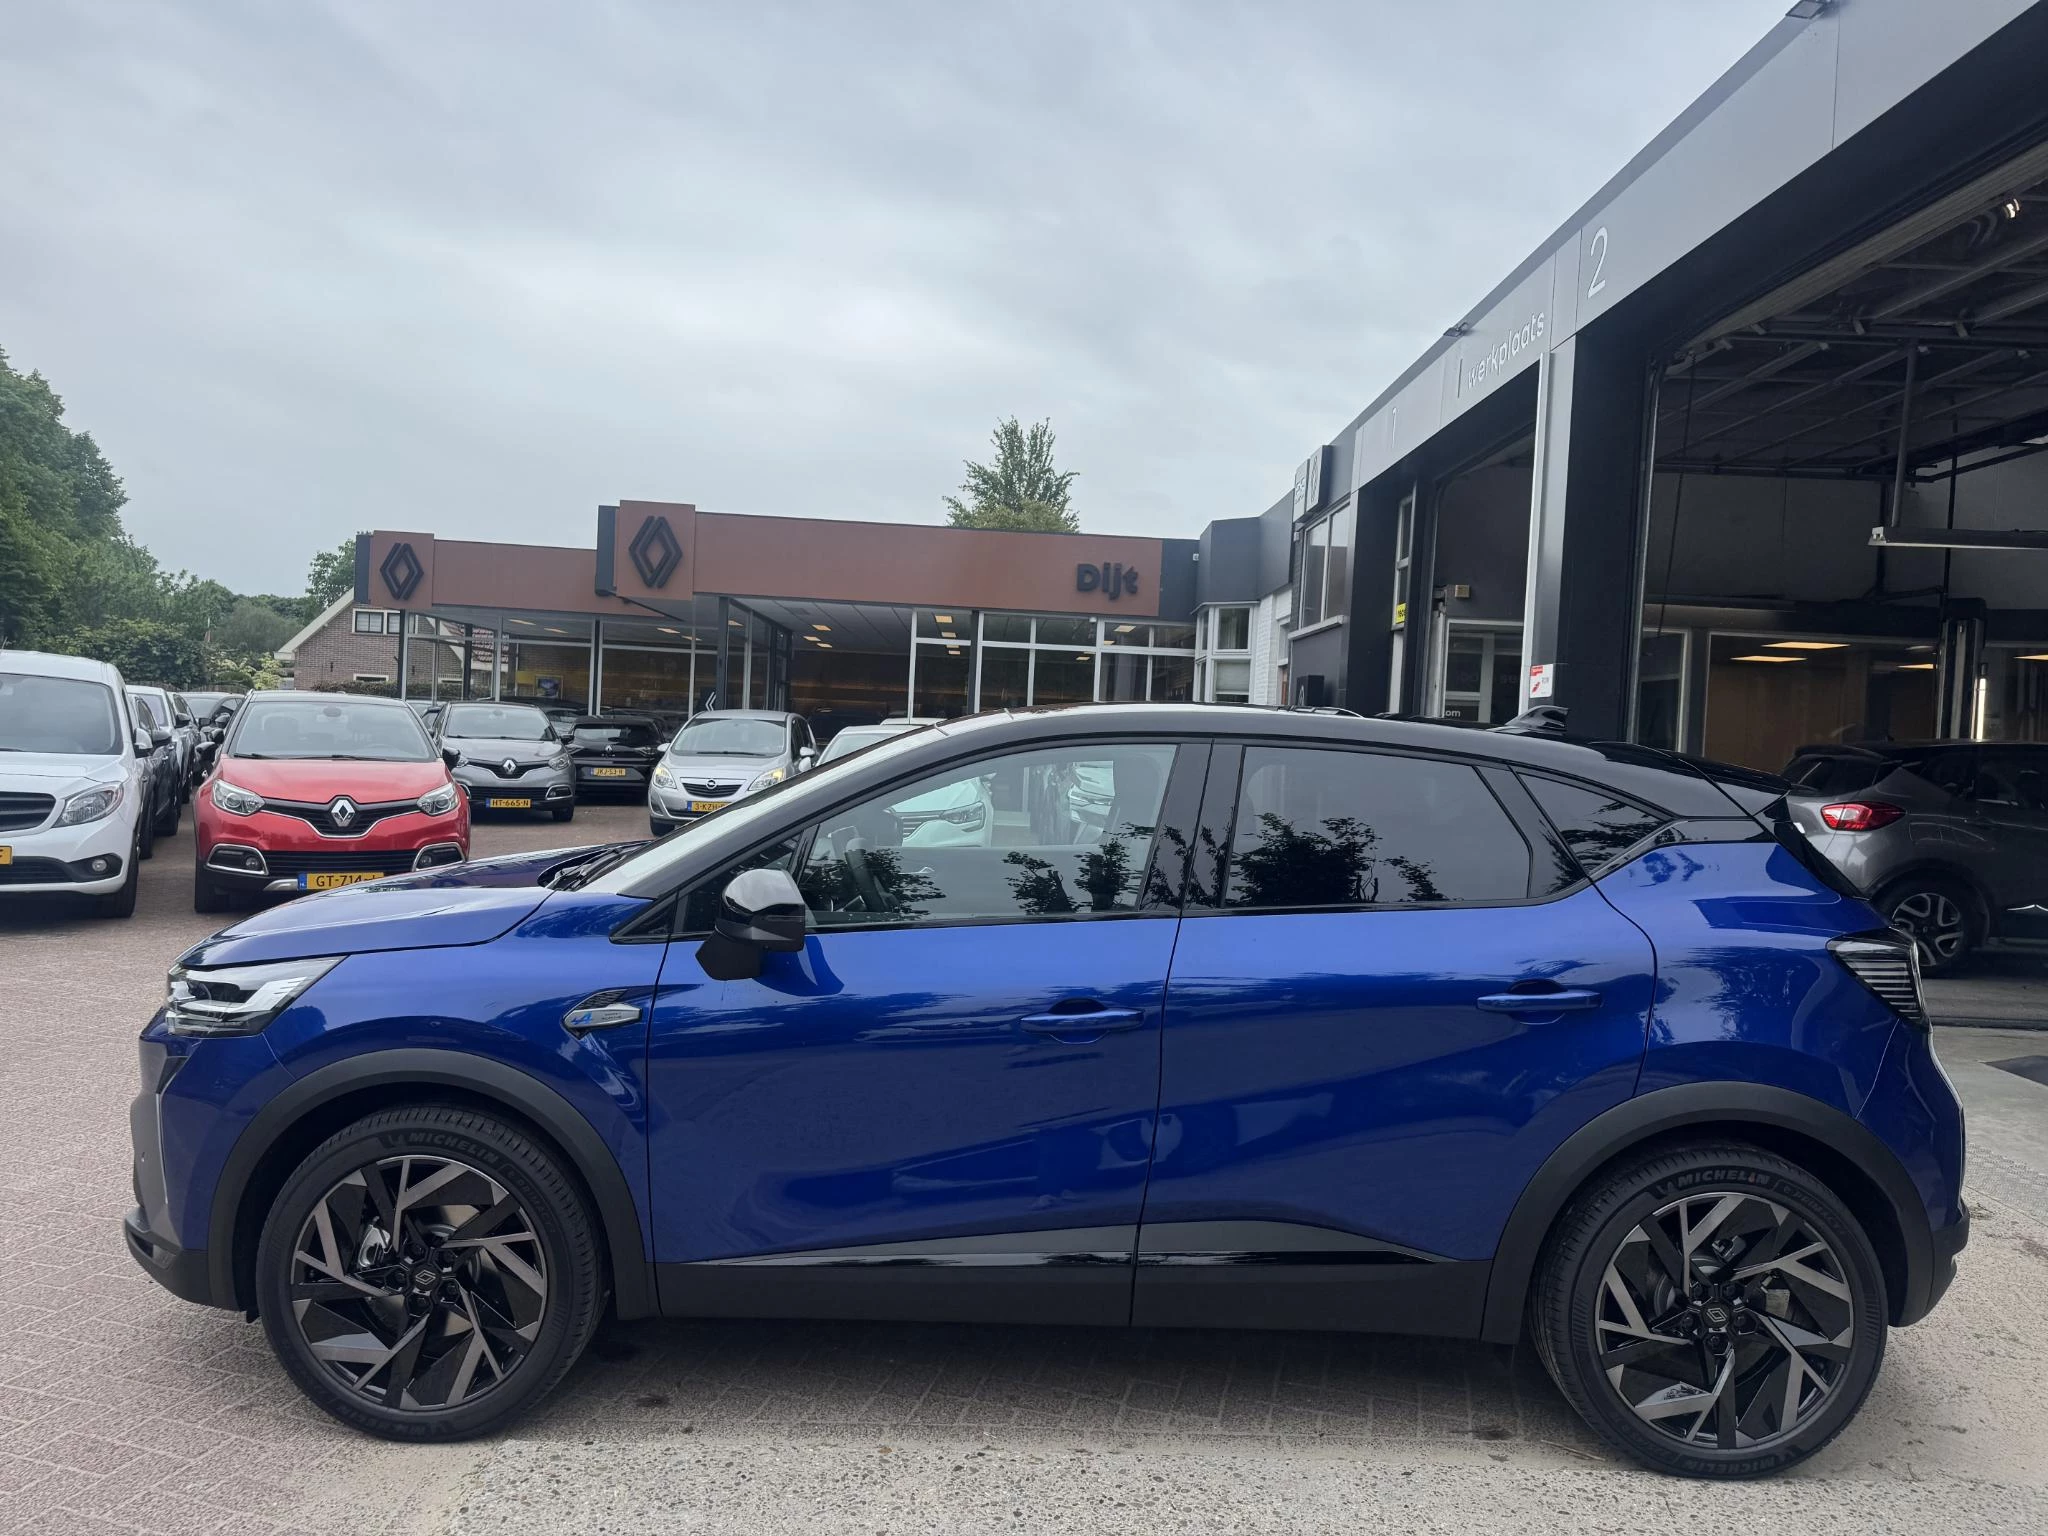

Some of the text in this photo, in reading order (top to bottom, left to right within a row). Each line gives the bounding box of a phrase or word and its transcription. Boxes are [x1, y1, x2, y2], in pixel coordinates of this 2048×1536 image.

[1587, 226, 1608, 299] 2
[1467, 311, 1545, 391] werkplaats
[492, 799, 529, 807] HT-665-N
[408, 1131, 500, 1165] MICHELIN
[1678, 1169, 1770, 1188] MICHELIN
